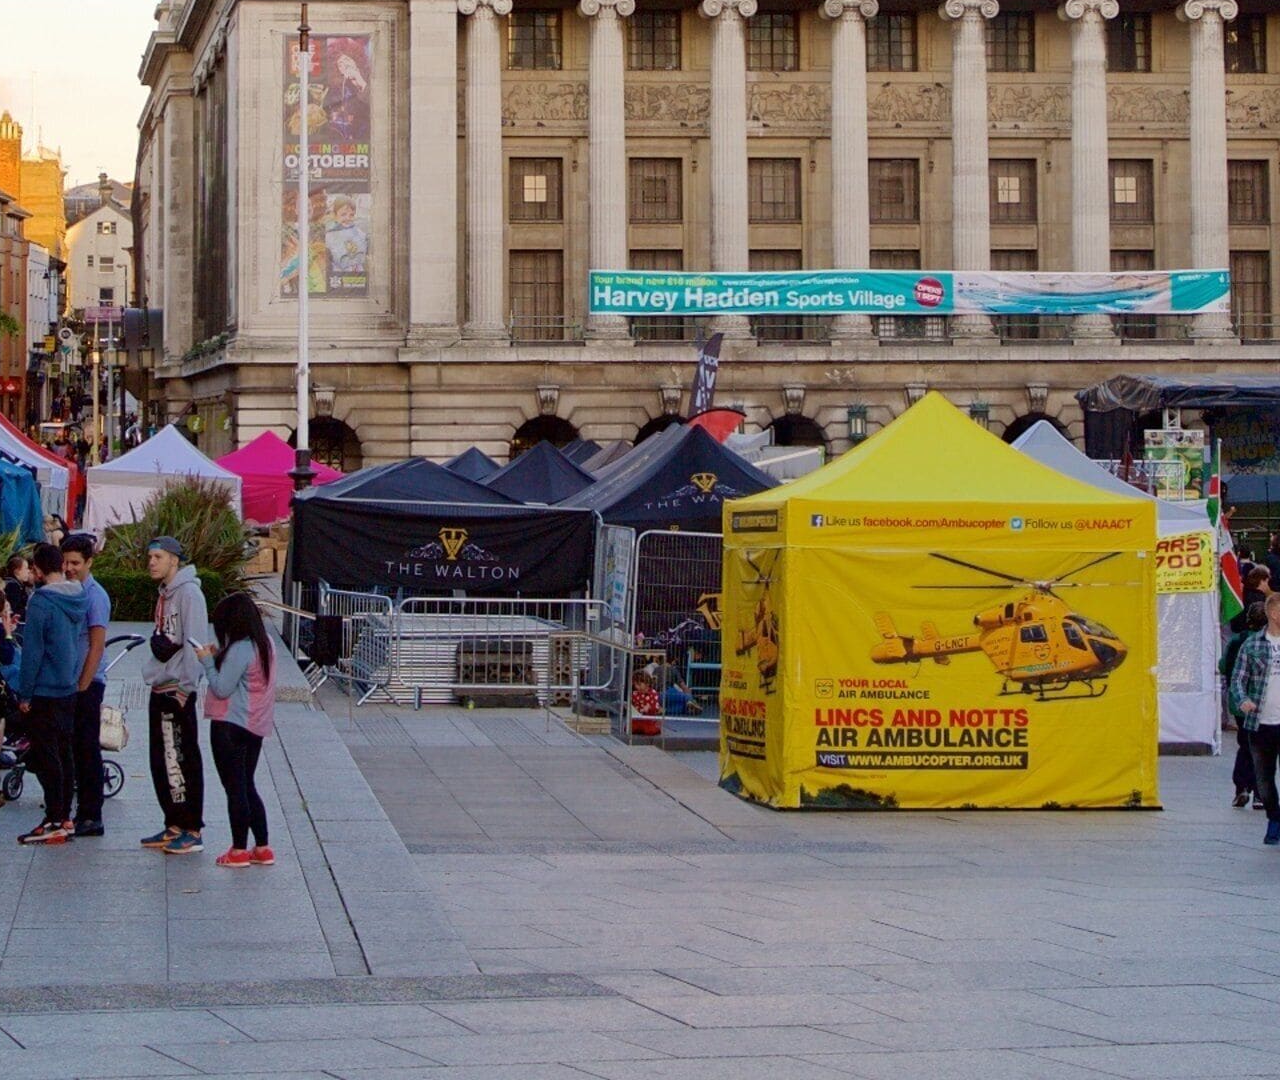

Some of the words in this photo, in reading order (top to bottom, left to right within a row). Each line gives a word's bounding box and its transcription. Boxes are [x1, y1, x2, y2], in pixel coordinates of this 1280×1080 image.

[285, 144, 369, 153] NOTINGHAM
[593, 275, 614, 284] Your
[615, 275, 644, 285] brand
[646, 277, 665, 286] new
[593, 286, 682, 311] Harvey
[684, 287, 779, 308] Hadden
[785, 290, 844, 309] Sports
[847, 289, 906, 309] Village
[643, 498, 682, 510] THE
[826, 516, 847, 526] Like
[848, 518, 861, 527] us
[863, 517, 1006, 530] facebook.com/Ambucopter
[1025, 518, 1058, 529] Follow
[1060, 520, 1073, 529] us
[1074, 519, 1133, 531] @LNAACT
[385, 561, 423, 576] THE
[435, 564, 520, 580] WALTON
[837, 679, 870, 689] YOUR
[872, 679, 909, 689] LOCAL
[837, 690, 858, 699] AIR
[859, 690, 930, 700] AMBULANCE
[815, 708, 884, 727] LINCS
[891, 709, 942, 727] AND
[949, 708, 1029, 727] NOTTS
[815, 728, 859, 747] AIR
[865, 728, 1029, 748] AMBULANCE
[819, 753, 846, 766] VISIT
[847, 754, 1023, 767] WWW.AMBUCOPTER.ORG.UK
